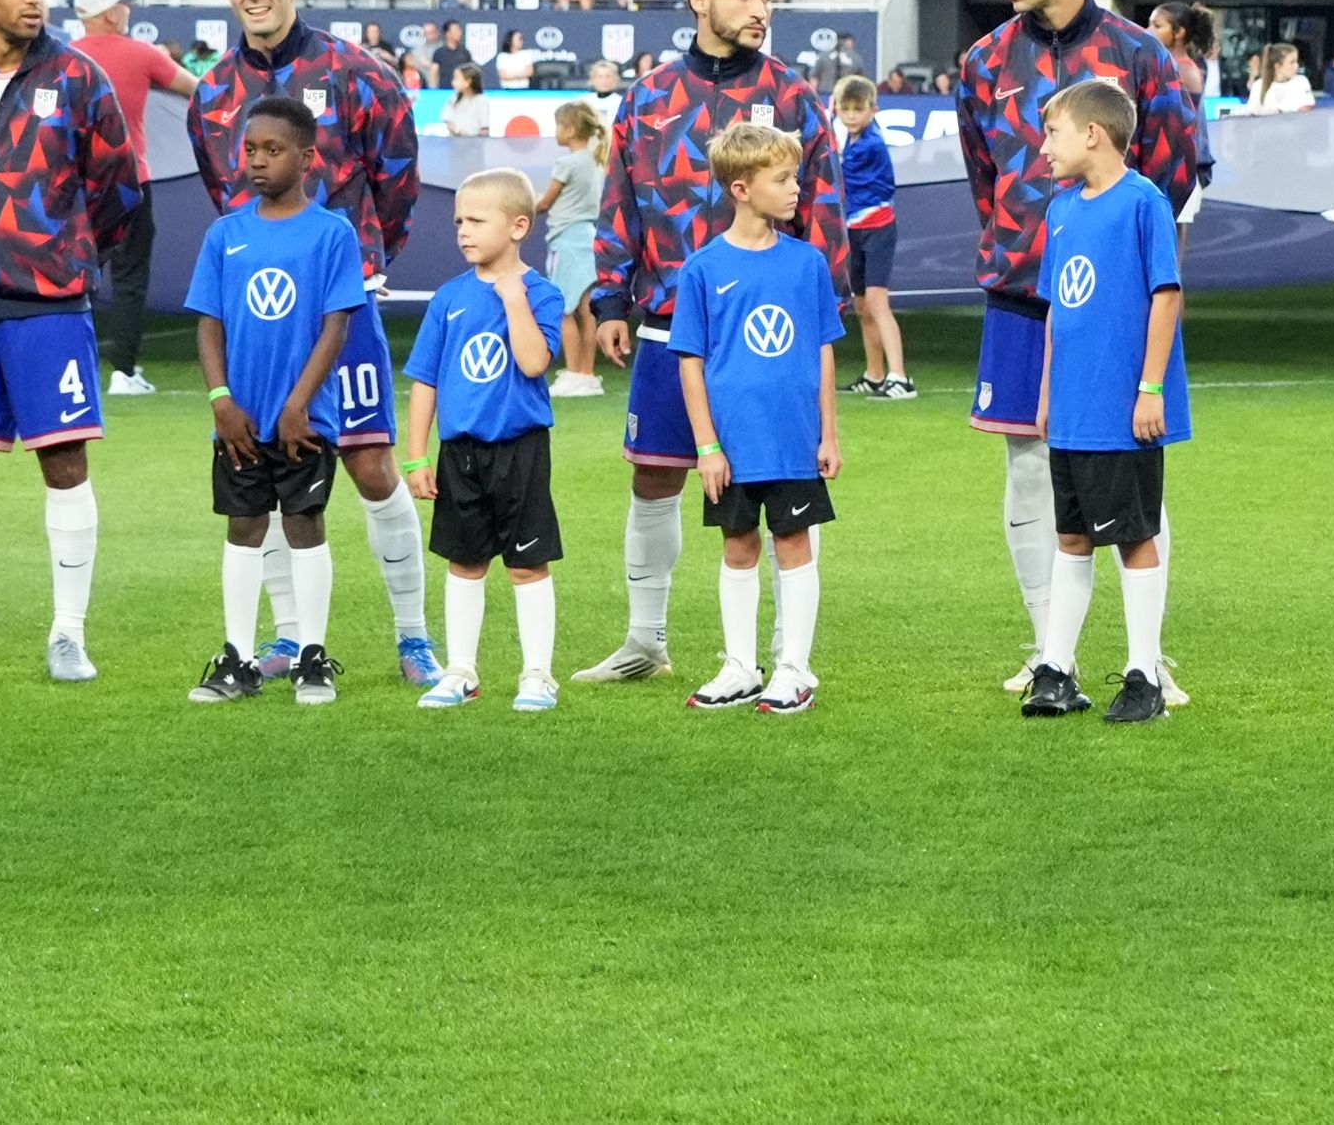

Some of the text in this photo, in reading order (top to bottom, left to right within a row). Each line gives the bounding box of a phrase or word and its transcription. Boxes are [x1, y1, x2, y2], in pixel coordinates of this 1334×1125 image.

[306, 91, 325, 101] USA
[754, 106, 773, 115] USA
[58, 359, 86, 404] 4
[337, 363, 380, 410] 10
